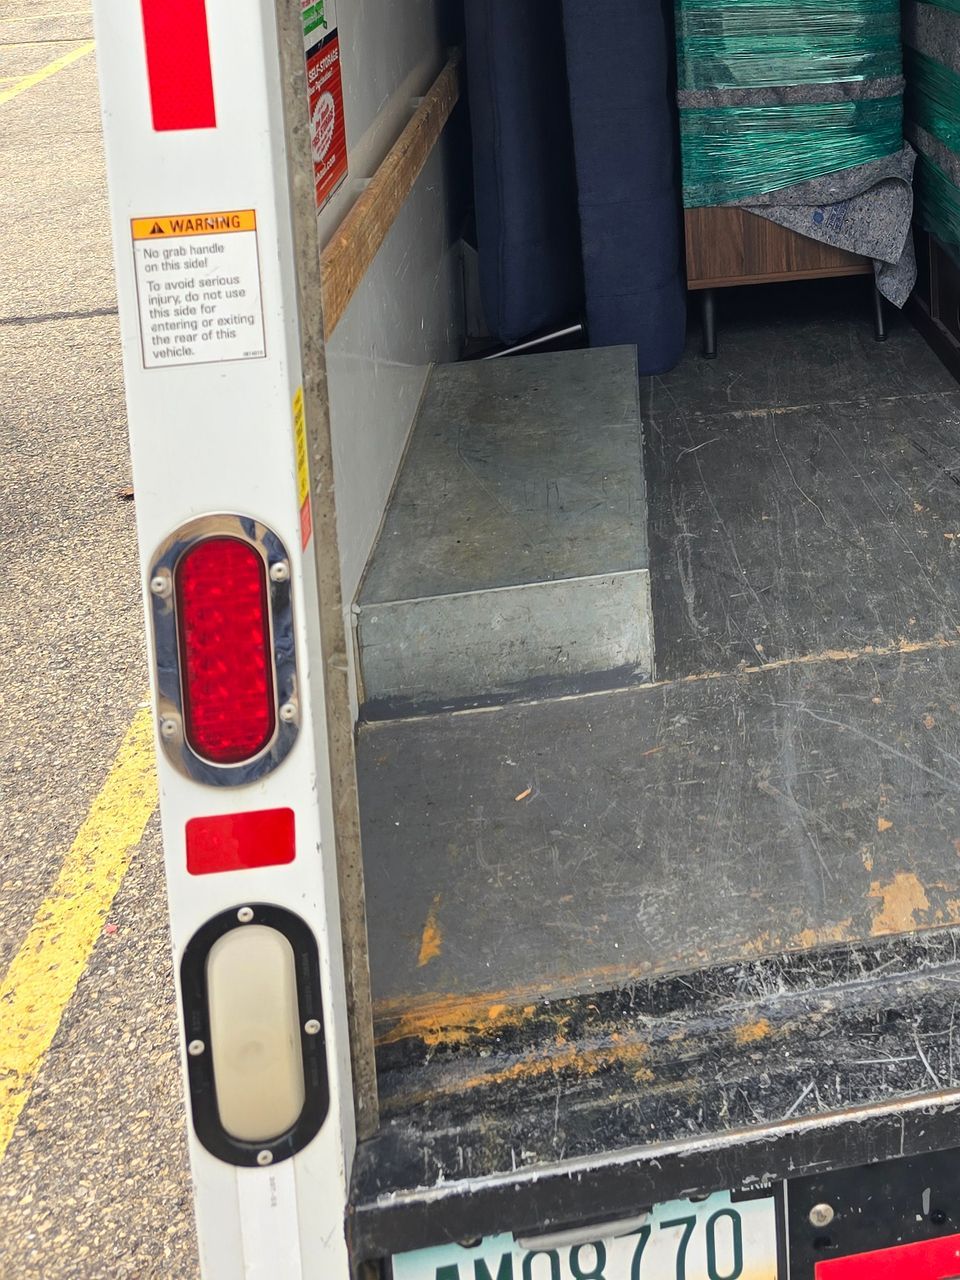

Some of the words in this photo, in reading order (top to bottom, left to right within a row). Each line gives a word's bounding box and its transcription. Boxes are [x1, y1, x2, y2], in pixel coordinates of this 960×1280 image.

[169, 215, 241, 233] WARNING
[143, 248, 159, 259] No
[162, 245, 187, 260] grab
[189, 243, 225, 255] handle
[144, 264, 158, 272] on
[161, 261, 180, 271] this
[183, 258, 209, 270] side!
[147, 280, 161, 292] To
[164, 278, 195, 291] avoid
[198, 275, 241, 288] serious
[148, 294, 181, 306] injury,
[184, 291, 199, 302] do
[202, 289, 223, 300] not
[225, 288, 246, 298] use
[149, 308, 170, 319] this
[173, 306, 197, 317] side
[200, 303, 217, 314] for
[150, 319, 198, 333] entering
[201, 318, 214, 328] or
[217, 313, 255, 326] exiting
[151, 334, 171, 346] the
[174, 333, 198, 344] rear
[201, 330, 214, 341] of
[215, 328, 237, 340] this
[152, 346, 196, 359] vehicle.
[434, 1207, 744, 1280] 8770
